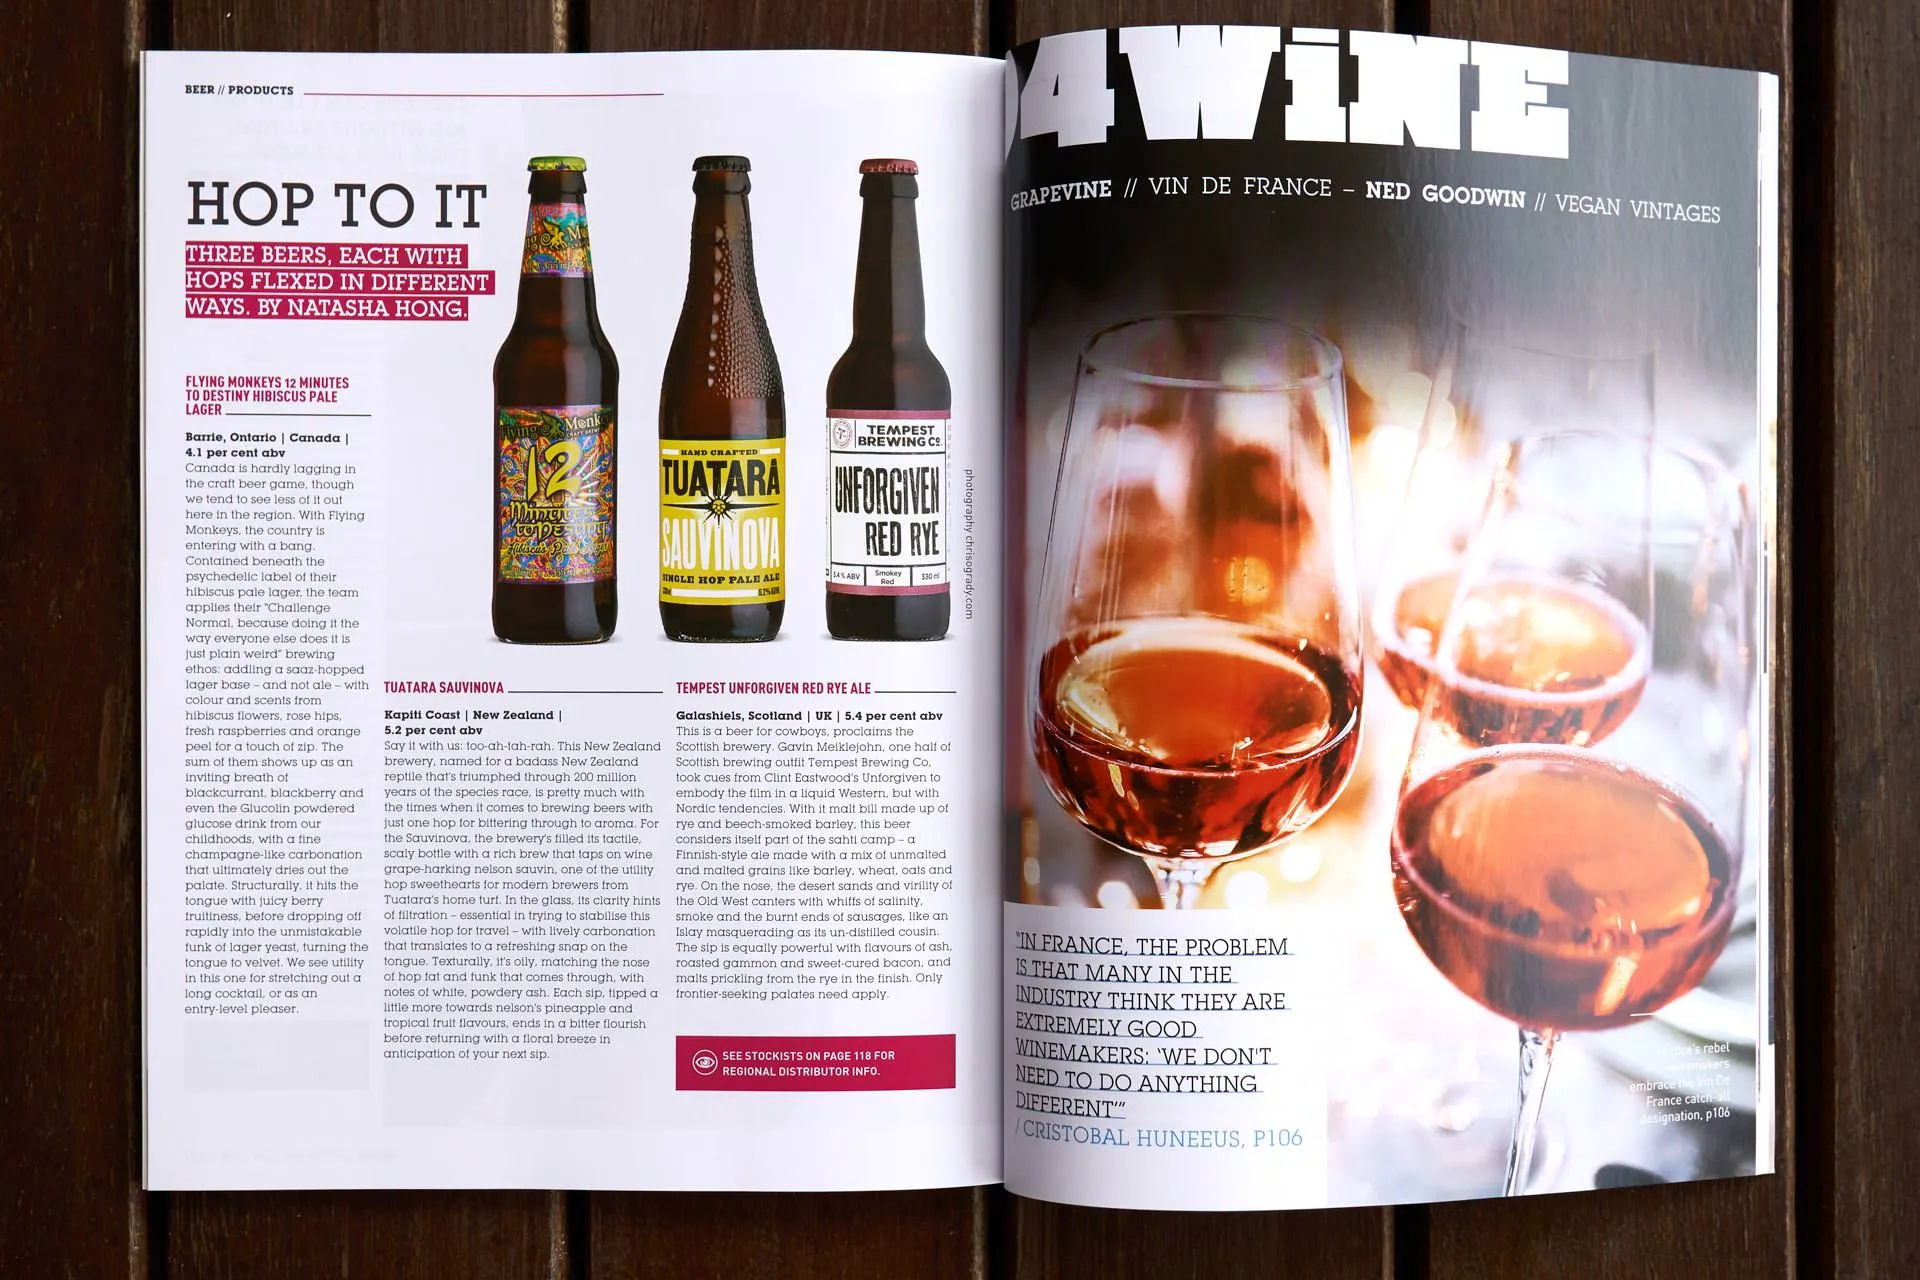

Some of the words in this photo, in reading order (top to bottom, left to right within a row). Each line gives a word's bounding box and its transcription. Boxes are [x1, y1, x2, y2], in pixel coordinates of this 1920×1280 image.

[185, 85, 215, 94] BEER
[228, 85, 294, 95] PRODUCTS
[188, 181, 314, 226] HOP
[334, 183, 414, 228] TO
[435, 184, 487, 228] IT
[1011, 180, 1112, 211] GRAPEVINE
[1148, 177, 1189, 195] VIN
[1202, 176, 1231, 194] DE
[1244, 177, 1331, 196] FRANCE
[1366, 181, 1410, 200] NED
[1422, 184, 1527, 209] GOODWIN
[1555, 194, 1621, 216] VEGAN
[1629, 200, 1720, 224] VINTAGES
[186, 245, 254, 263] THREE
[261, 246, 332, 266] BEERS,
[339, 247, 399, 264] EACH
[405, 247, 462, 265] WITH
[186, 271, 244, 289] HOPS
[251, 272, 334, 290] FLEXED
[340, 273, 364, 291] IN
[371, 274, 489, 291] DIFFERENT
[185, 297, 250, 315] WAYS.
[257, 298, 282, 316] BY
[287, 299, 389, 317] NATASHA
[395, 300, 468, 318] HONG.
[186, 375, 225, 388] FLYING
[228, 376, 281, 388] MONKEYS
[285, 378, 296, 388] 12
[299, 377, 349, 389] MINUTES
[186, 389, 200, 401] TO
[203, 389, 250, 402] DESTINY
[253, 390, 306, 402] HIBISCUS
[309, 391, 337, 403] PALE
[186, 403, 222, 415] LAGER
[866, 424, 935, 436] TEMPEST
[186, 432, 226, 443] Barrie,
[230, 432, 277, 442] Ontario
[289, 433, 340, 443] Canada
[858, 436, 926, 447] BREWING
[185, 448, 202, 457] 4.1
[207, 450, 227, 459] per
[231, 448, 258, 457] cent
[262, 448, 286, 458] abv
[527, 440, 581, 500] 12
[662, 458, 780, 497] TUATARA
[835, 466, 939, 515] UNFORGIVEN
[963, 469, 975, 533] photography
[662, 517, 780, 571] SAUVINOVA
[865, 521, 902, 556] RED
[910, 520, 940, 556] RYE
[663, 573, 694, 584] SINGLE
[698, 575, 726, 585] HOP
[729, 575, 760, 585] PALE
[763, 572, 780, 582] ALE
[847, 572, 860, 580] ABV
[874, 569, 902, 578] Smokey
[963, 536, 975, 620] chrisogrady.com
[384, 681, 437, 693] TUATARA
[439, 681, 504, 693] SAUVINOVA
[676, 682, 726, 694] TEMPEST
[729, 682, 799, 694] UNFORGIVEN
[802, 682, 824, 694] RED
[827, 682, 847, 694] RYE
[850, 682, 871, 694] ALE
[384, 710, 422, 721] Kapiti
[425, 710, 460, 719] Coast
[473, 710, 500, 720] New
[503, 710, 554, 720] Zealand
[676, 711, 744, 722] Galashiels,
[748, 711, 802, 720] Scotland
[815, 711, 832, 720] UK
[845, 711, 862, 720] 5.4
[866, 713, 886, 722] per
[890, 712, 916, 720] cent
[920, 711, 943, 720] abv
[385, 725, 402, 735] 5.2
[405, 727, 426, 737] per
[429, 726, 456, 735] cent
[459, 726, 483, 735] abv
[1042, 934, 1128, 956] FRANCE,
[1136, 938, 1178, 956] THE
[1185, 938, 1288, 956] PROBLEM
[1016, 958, 1027, 976] IS
[1032, 960, 1078, 980] THAT
[1085, 964, 1153, 983] MANY
[1158, 966, 1182, 983] IN
[1190, 966, 1232, 983] THE
[676, 988, 768, 1001] frontier-seeking
[771, 989, 815, 1001] palates
[818, 989, 848, 999] need
[851, 989, 889, 1001] apply.
[1016, 984, 1102, 1009] INDUSTRY
[1108, 992, 1175, 1010] THINK
[1181, 993, 1237, 1011] THEY
[1242, 992, 1286, 1010] ARE
[184, 1004, 248, 1016] entry-level
[251, 1004, 299, 1016] pleaser.
[1016, 1011, 1122, 1037] EXTREMELY
[1127, 1020, 1197, 1038] GOOD
[1016, 1037, 1149, 1065] WINEMAKERS:
[1204, 1048, 1271, 1066] DON'T
[1703, 1041, 1730, 1054] rebel
[383, 1049, 455, 1060] anticipation
[458, 1049, 469, 1059] of
[472, 1051, 500, 1061] your
[502, 1049, 527, 1059] next
[530, 1049, 550, 1061] sip.
[723, 1051, 742, 1060] SEE
[745, 1051, 803, 1061] STOCKISTS
[805, 1052, 820, 1061] ON
[823, 1051, 851, 1061] PAGE
[854, 1051, 871, 1060] 118
[874, 1051, 895, 1060] FOR
[723, 1066, 776, 1076] REGIONAL
[779, 1067, 849, 1076] DISTRIBUTOR
[852, 1066, 880, 1076] INFO.
[1016, 1064, 1059, 1086] NEED
[1065, 1071, 1092, 1089] TO
[1099, 1073, 1131, 1091] DO
[1138, 1075, 1257, 1093] ANYTHING
[1630, 1079, 1676, 1092] embrace
[1646, 1095, 1682, 1107] France
[1706, 1106, 1730, 1122] p106
[1137, 1130, 1245, 1149] HUNEEUS,
[1254, 1128, 1303, 1147] P106
